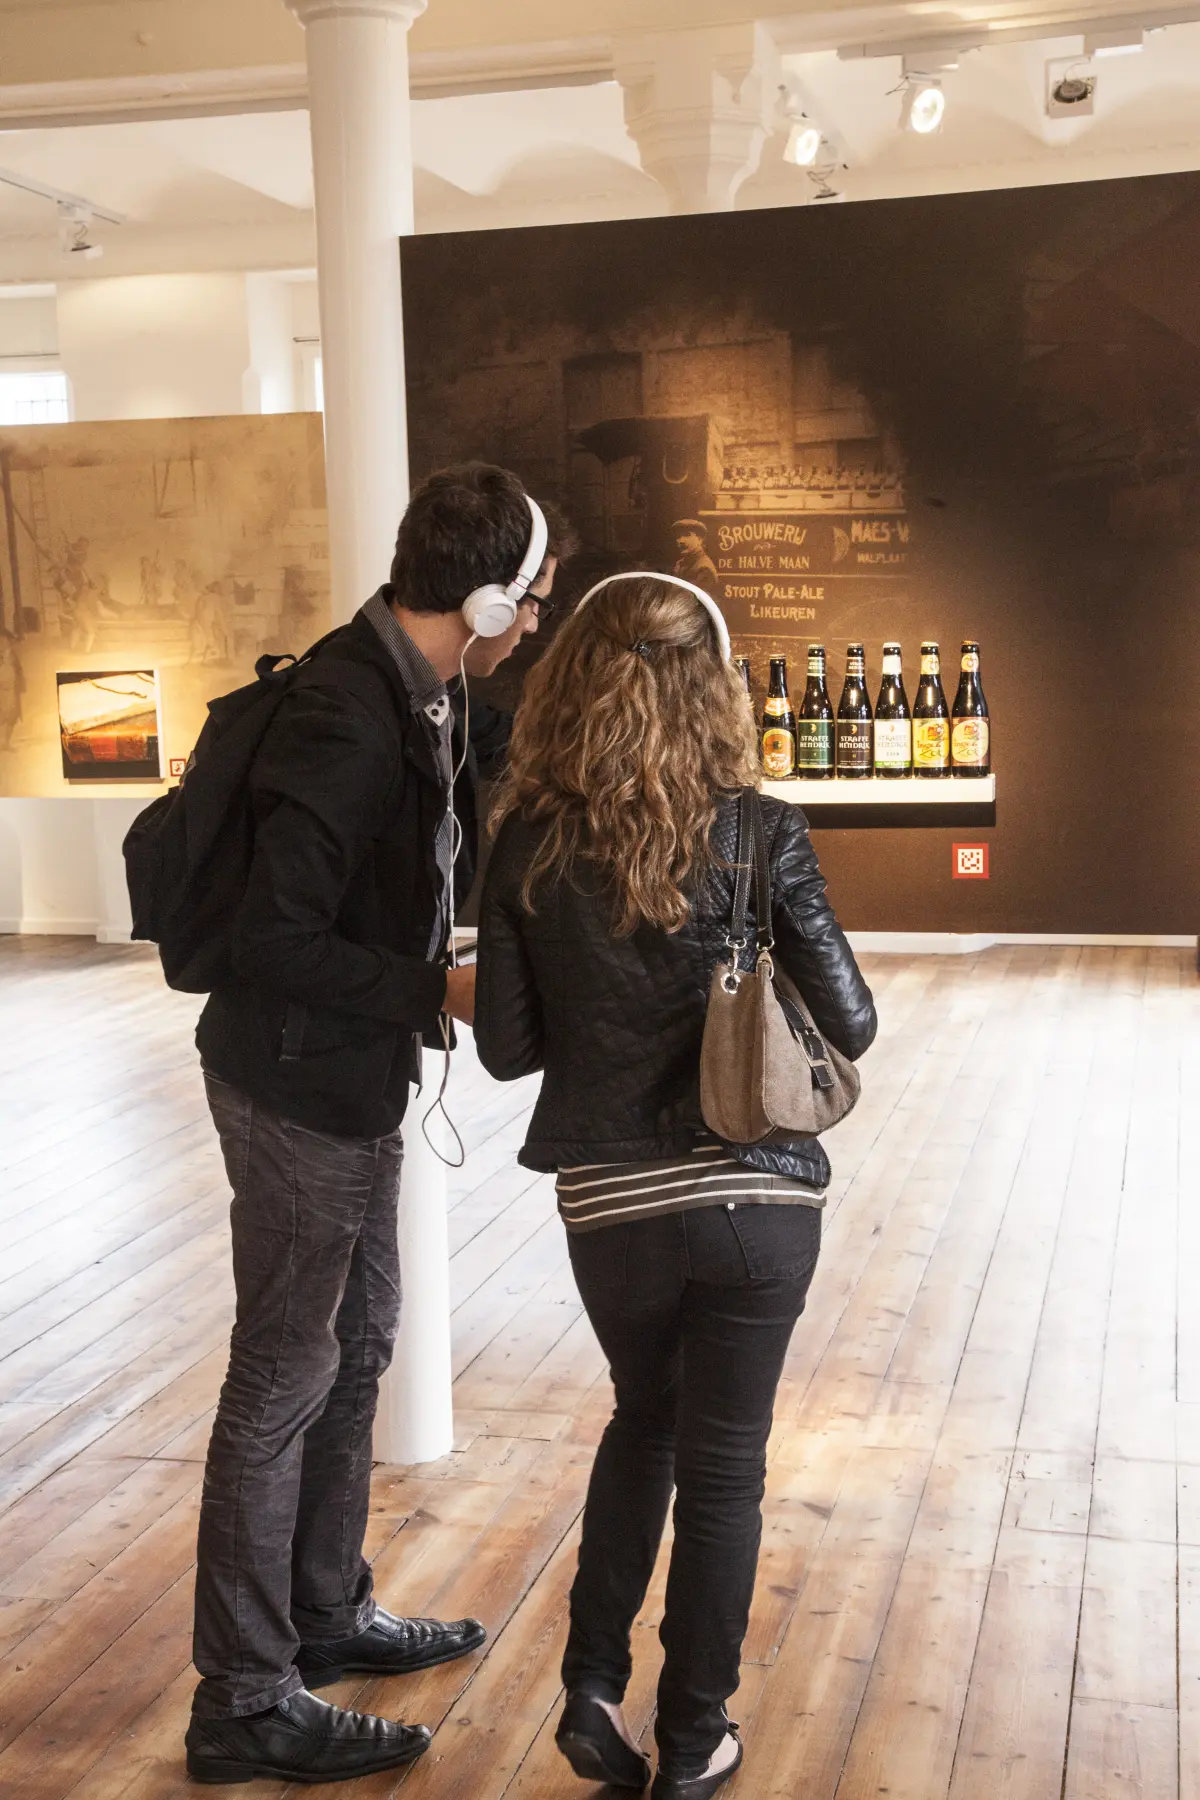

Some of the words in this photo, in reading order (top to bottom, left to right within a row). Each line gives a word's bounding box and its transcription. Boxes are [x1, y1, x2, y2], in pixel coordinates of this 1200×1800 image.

[718, 558, 733, 569] DE
[738, 556, 773, 569] HALVE
[779, 556, 810, 569] MAAN
[725, 584, 760, 598] STOUT
[750, 603, 816, 622] LIKEUREN
